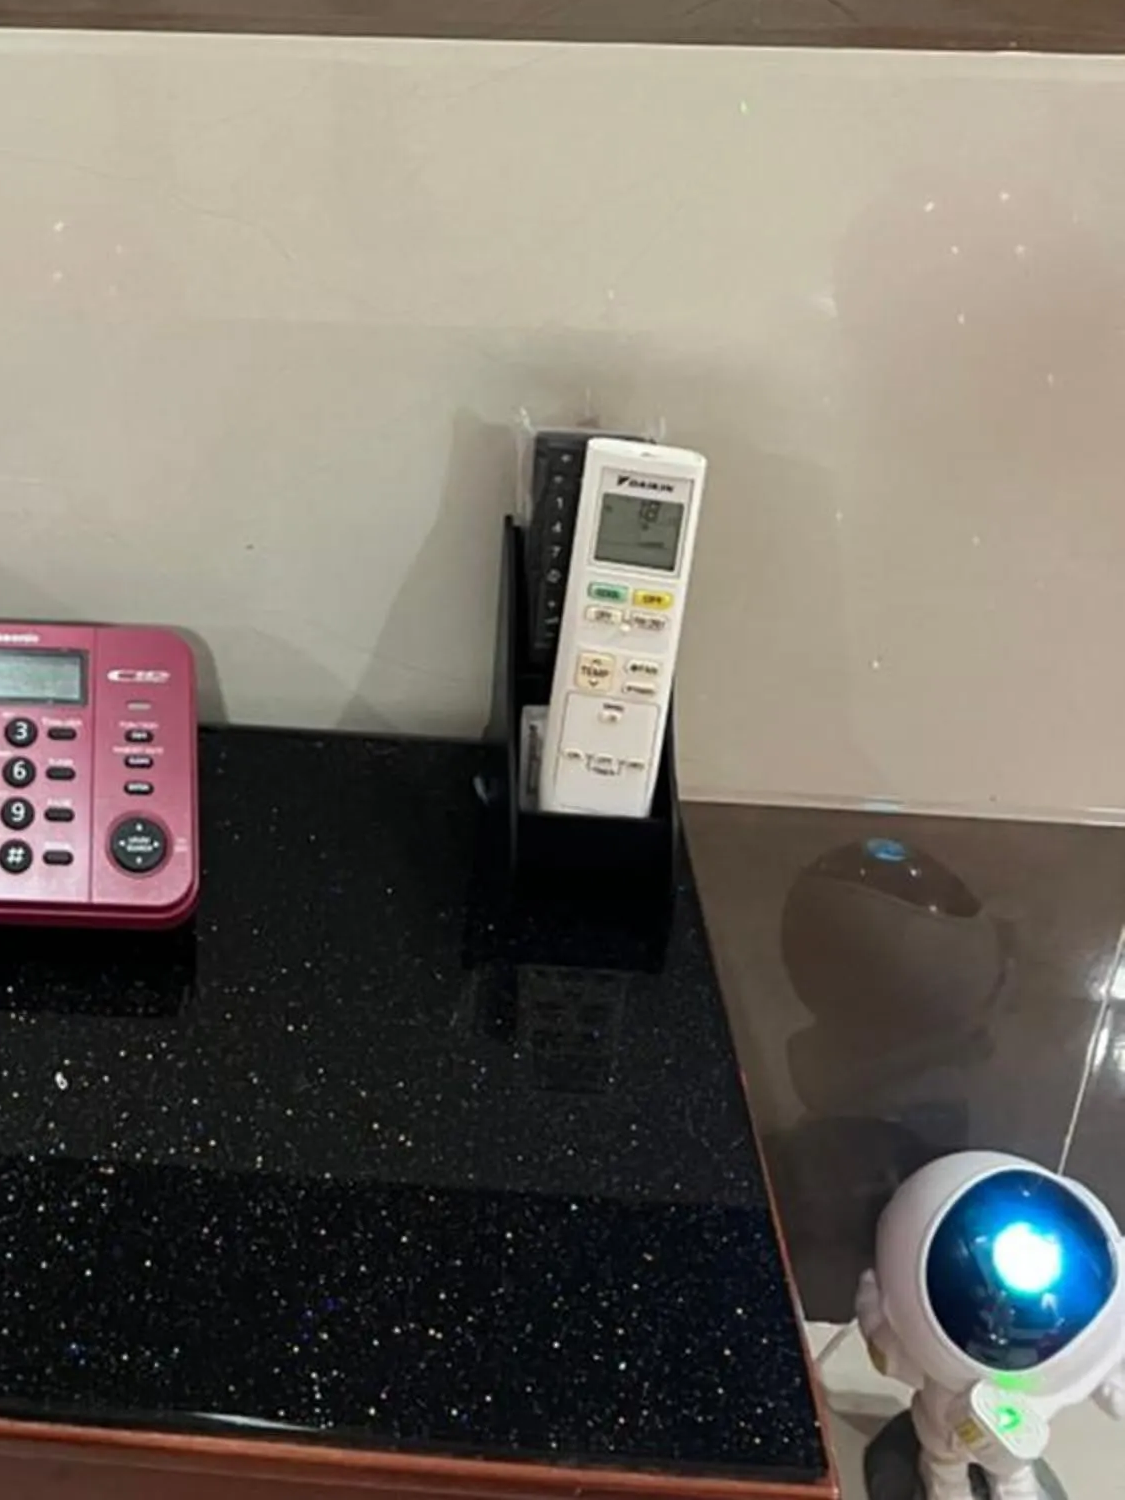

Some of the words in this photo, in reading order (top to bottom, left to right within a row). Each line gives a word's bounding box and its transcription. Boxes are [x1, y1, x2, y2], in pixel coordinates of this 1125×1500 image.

[15, 721, 28, 740] 3
[12, 760, 26, 780] 6
[11, 802, 26, 822] 9
